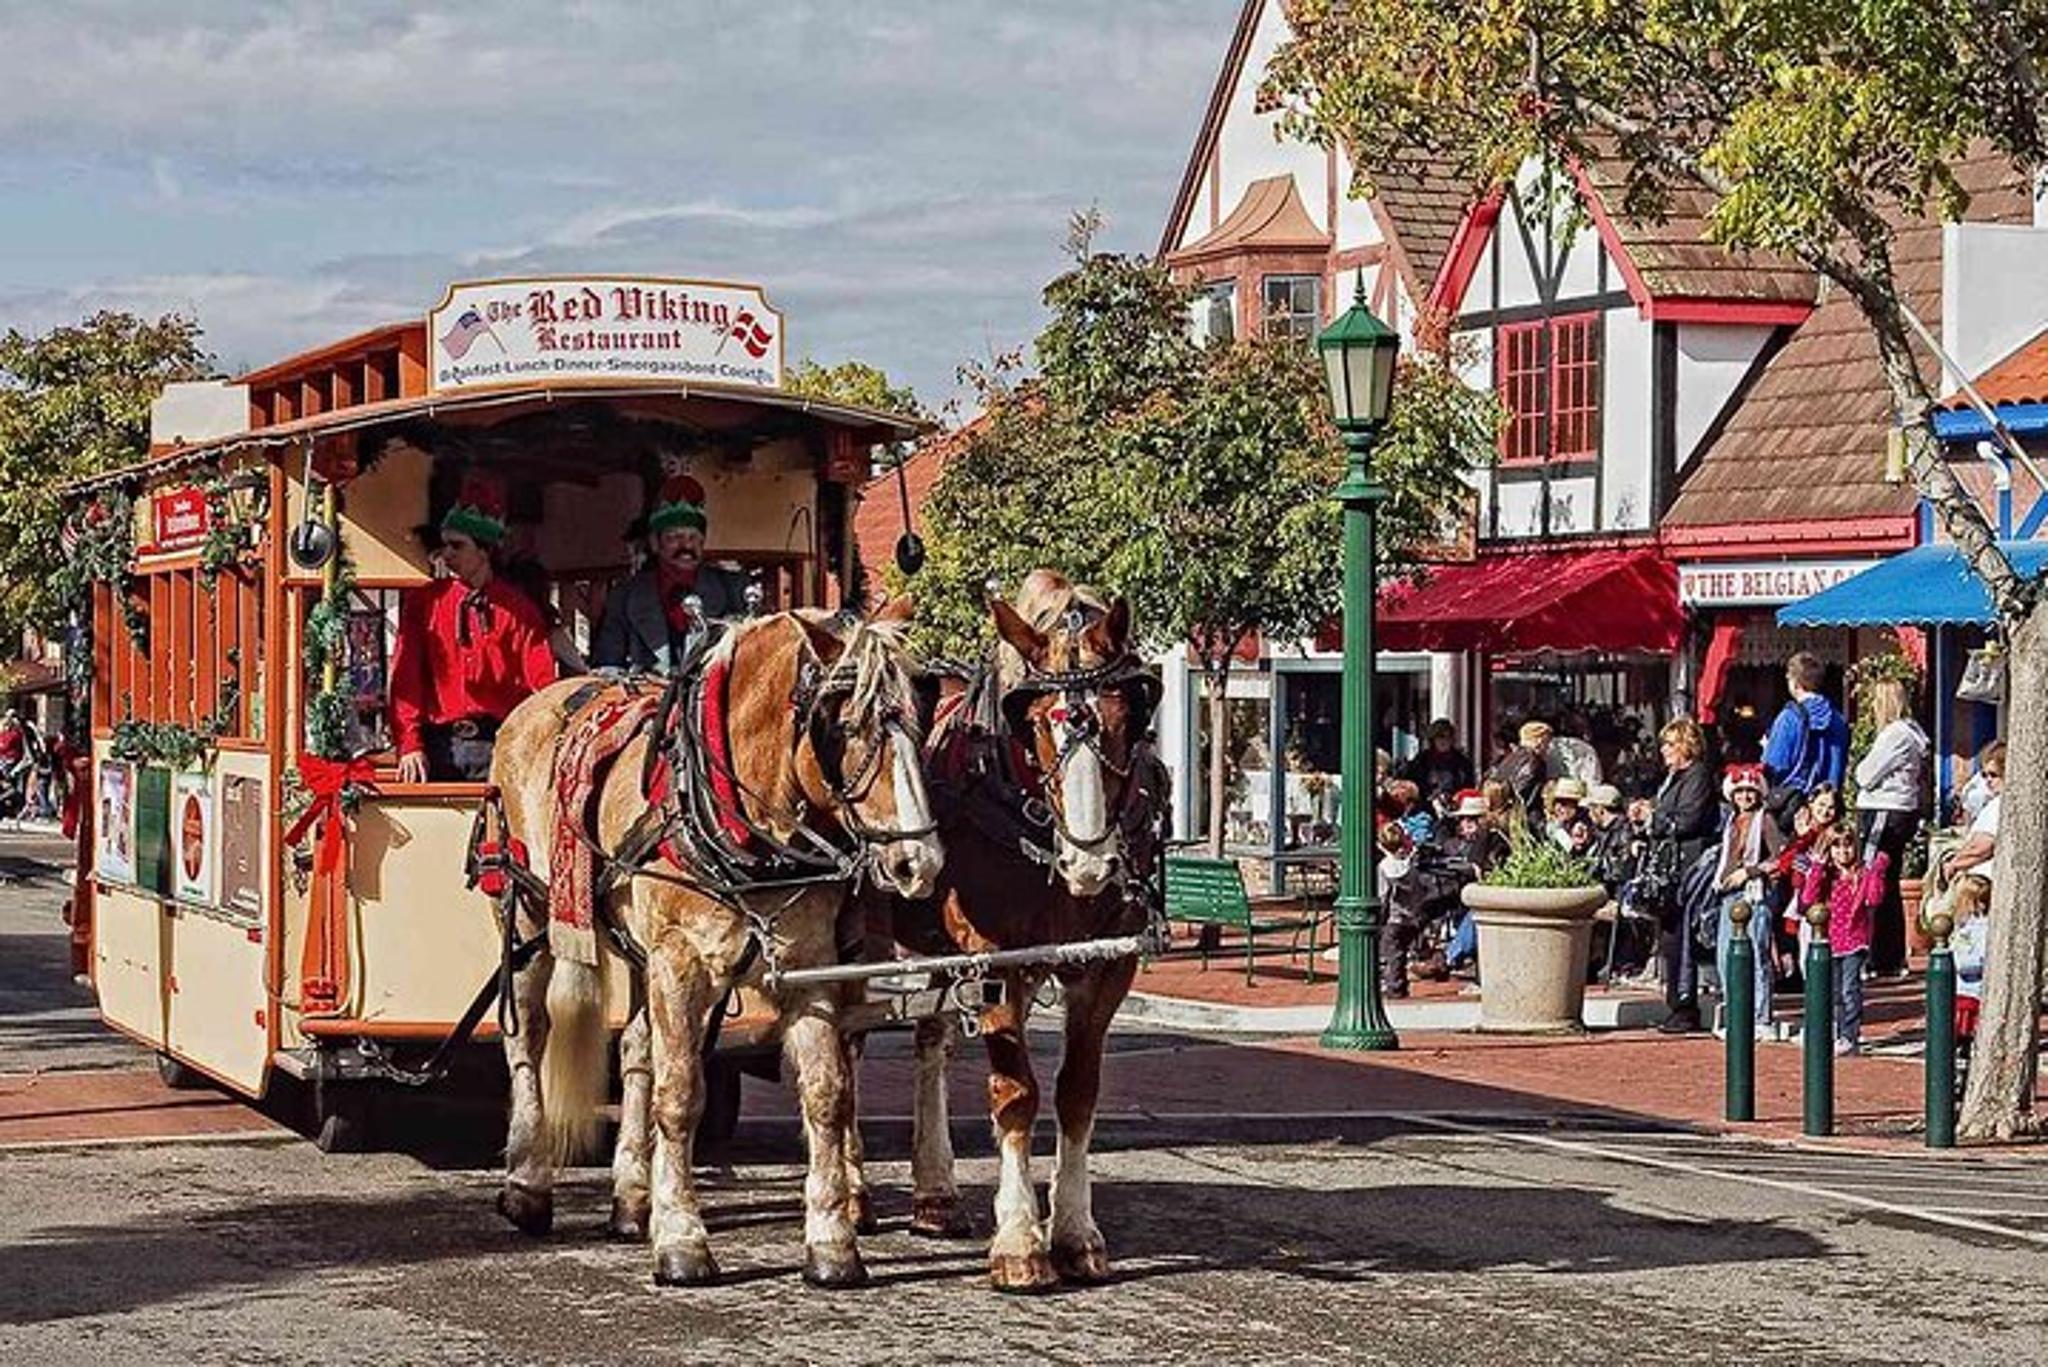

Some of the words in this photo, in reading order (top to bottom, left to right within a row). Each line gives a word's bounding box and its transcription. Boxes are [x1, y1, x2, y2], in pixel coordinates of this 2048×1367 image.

[486, 300, 523, 325] The
[527, 287, 602, 328] Red
[610, 287, 731, 335] Viking
[535, 326, 682, 351] Restaurant
[1698, 574, 1737, 598] THE
[1741, 569, 1827, 596] BELGIAN
